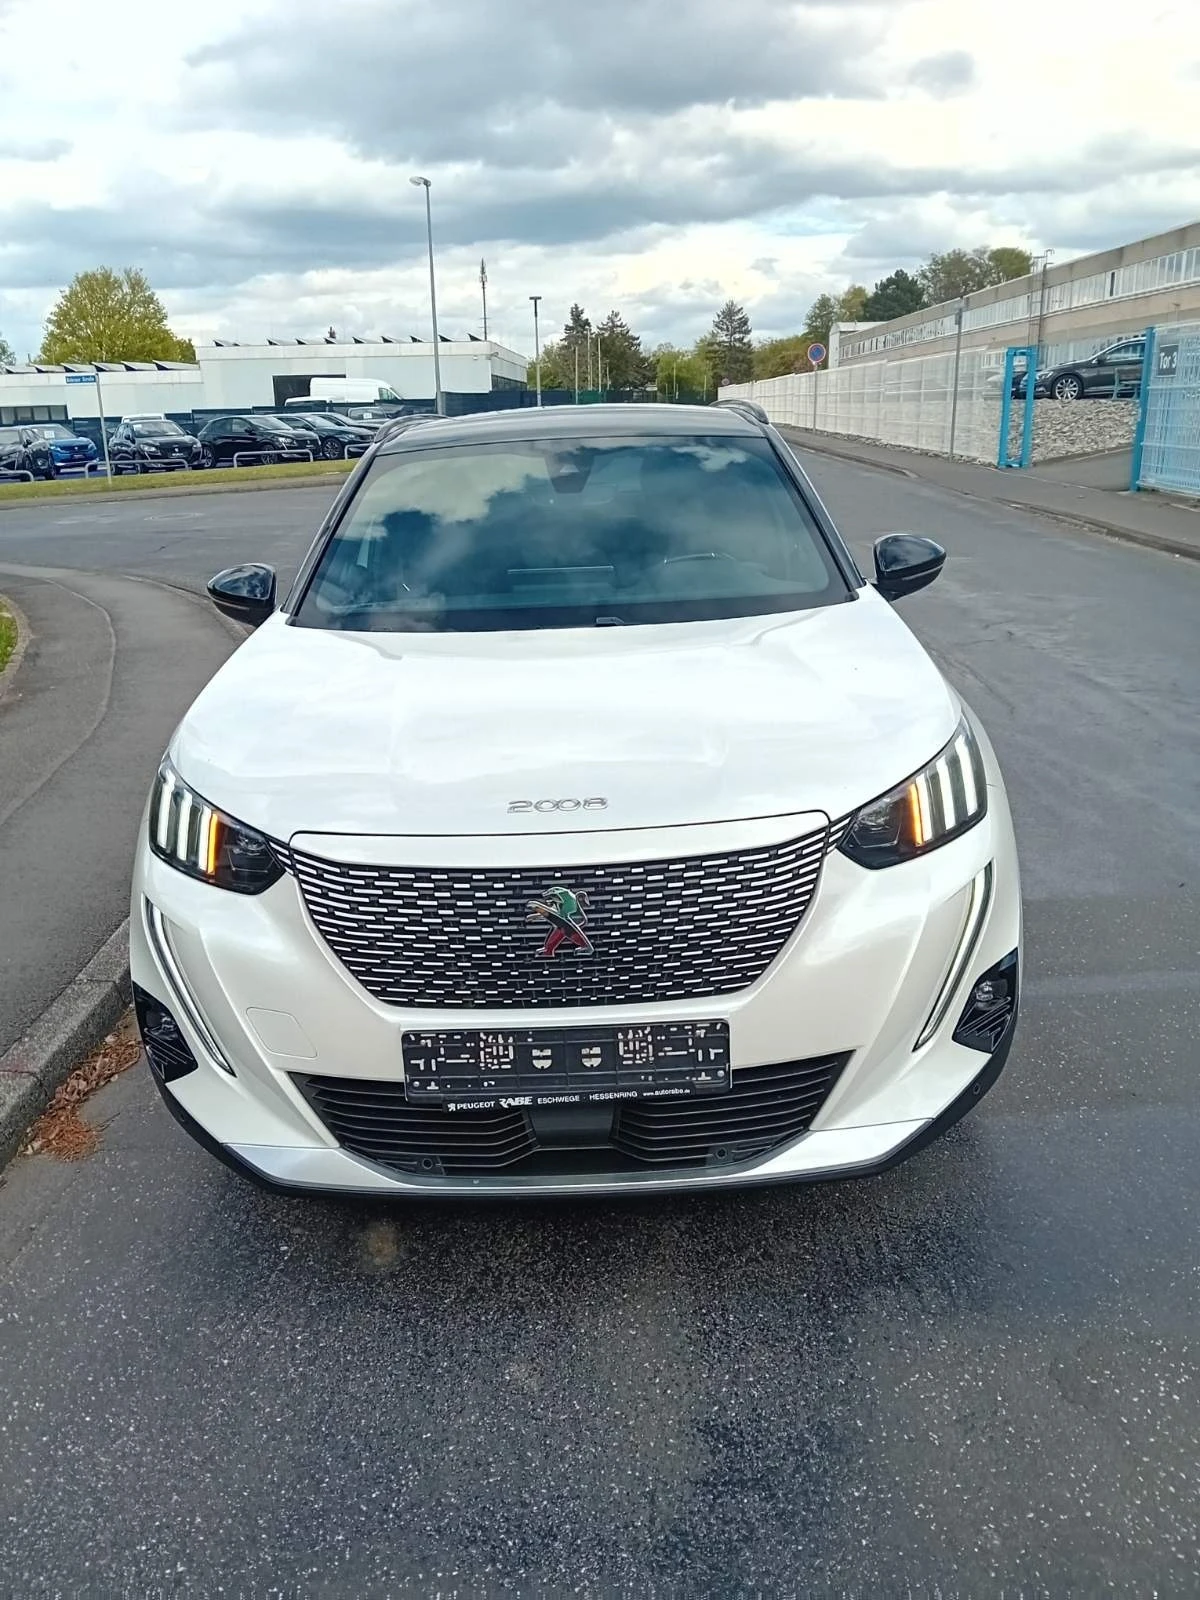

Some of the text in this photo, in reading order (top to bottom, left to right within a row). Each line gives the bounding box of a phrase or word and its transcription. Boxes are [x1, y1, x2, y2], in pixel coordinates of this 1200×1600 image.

[1160, 351, 1171, 369] Tor
[507, 797, 608, 813] 2008
[457, 1101, 495, 1110] PEUGEOT
[499, 1096, 533, 1108] RABE
[537, 1095, 580, 1104] ESCHWEGE
[589, 1091, 638, 1101] HESSENRING
